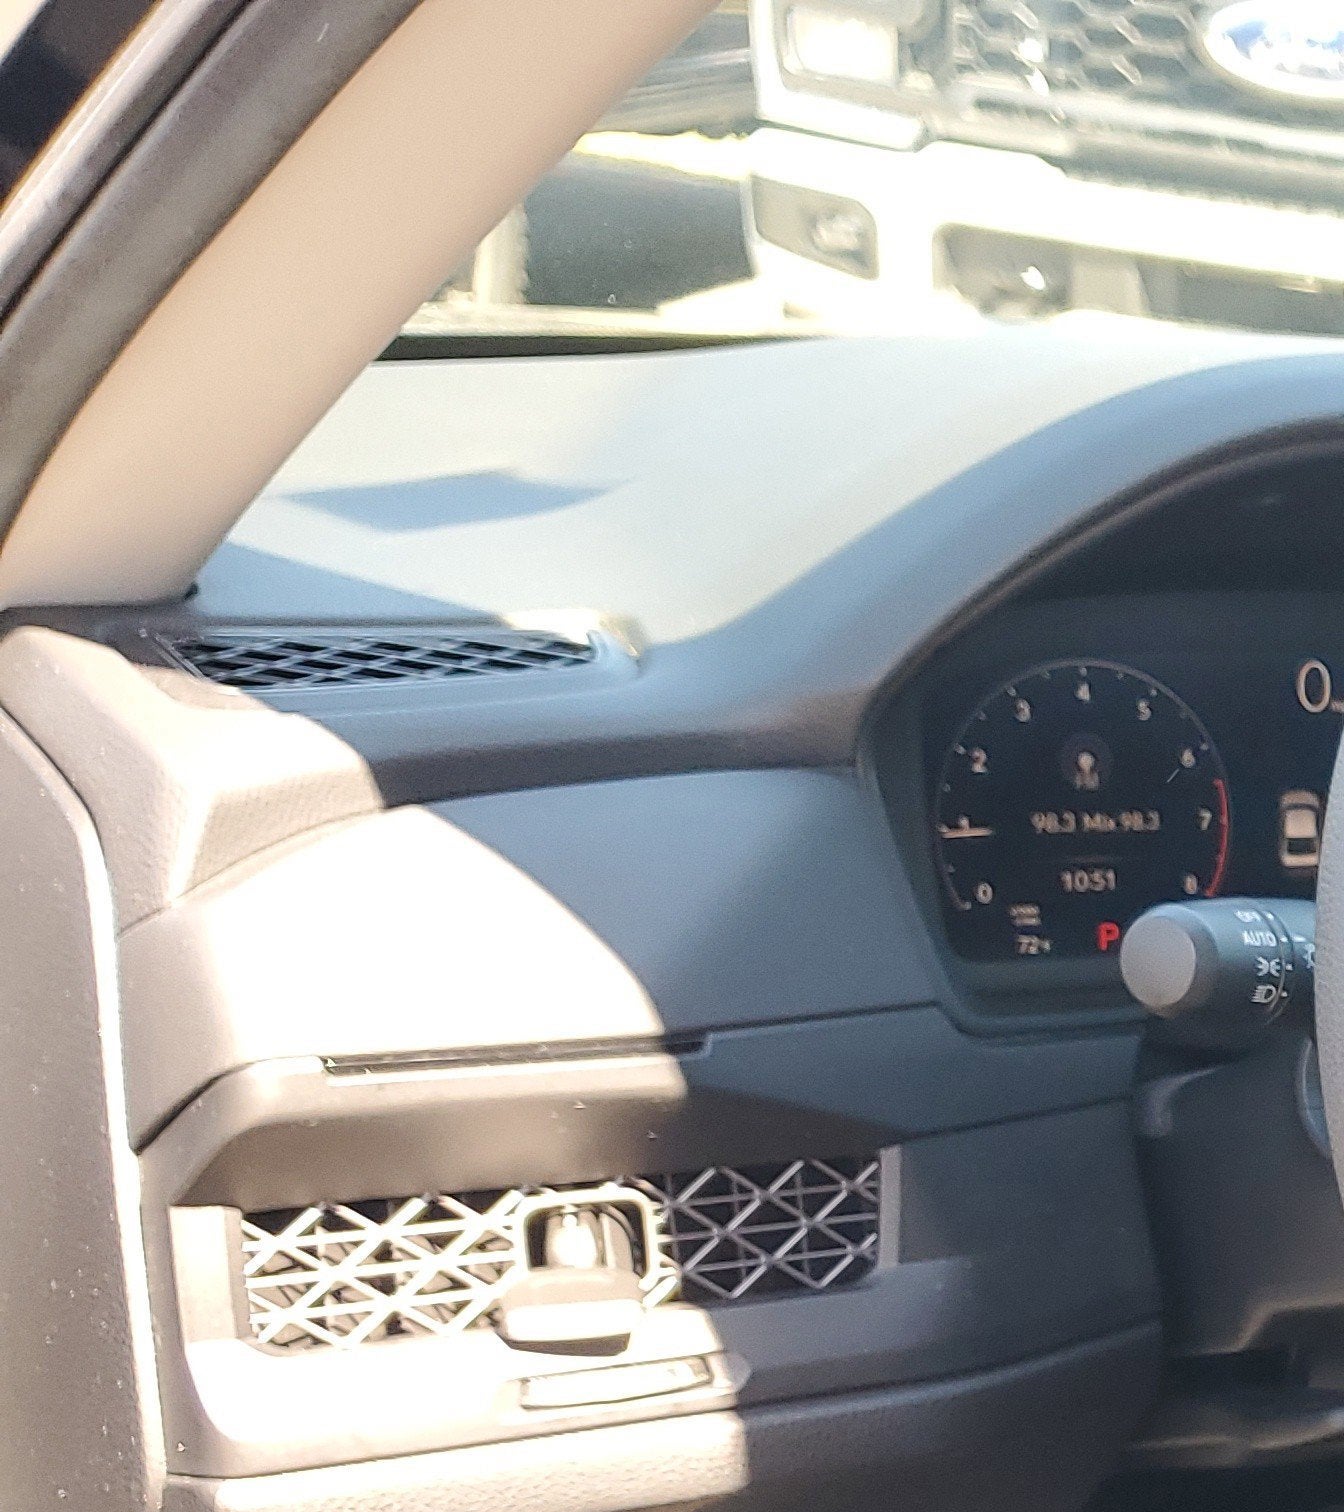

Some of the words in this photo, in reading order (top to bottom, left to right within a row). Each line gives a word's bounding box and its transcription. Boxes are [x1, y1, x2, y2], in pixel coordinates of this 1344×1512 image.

[1297, 659, 1331, 713] 0
[1096, 921, 1121, 951] P
[1242, 930, 1278, 947] AUTO
